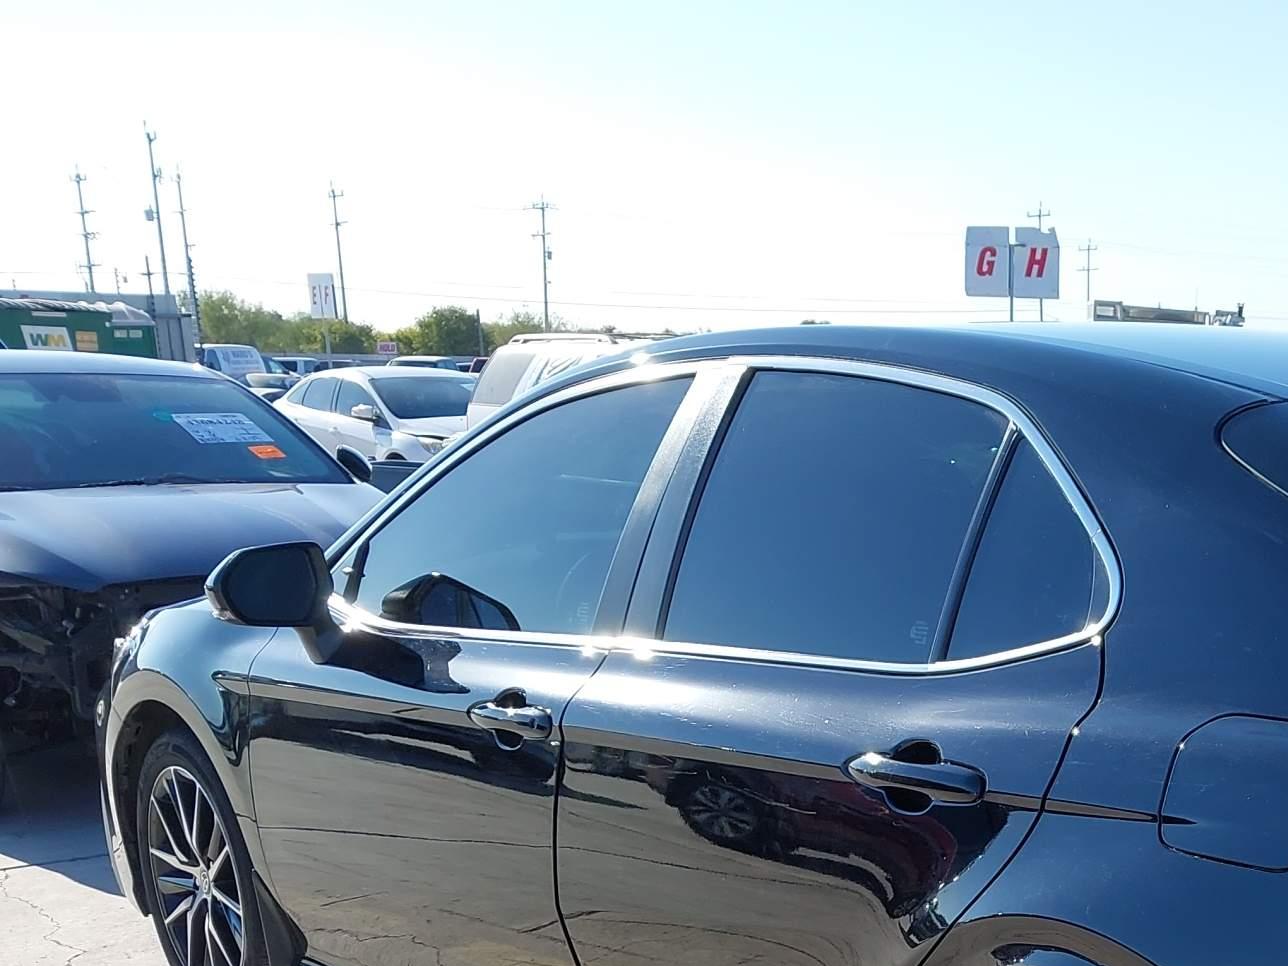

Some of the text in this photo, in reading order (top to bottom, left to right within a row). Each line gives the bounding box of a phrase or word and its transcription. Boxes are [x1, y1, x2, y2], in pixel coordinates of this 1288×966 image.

[976, 246, 1048, 278] G H
[312, 286, 330, 305] E F
[29, 333, 67, 347] WM
